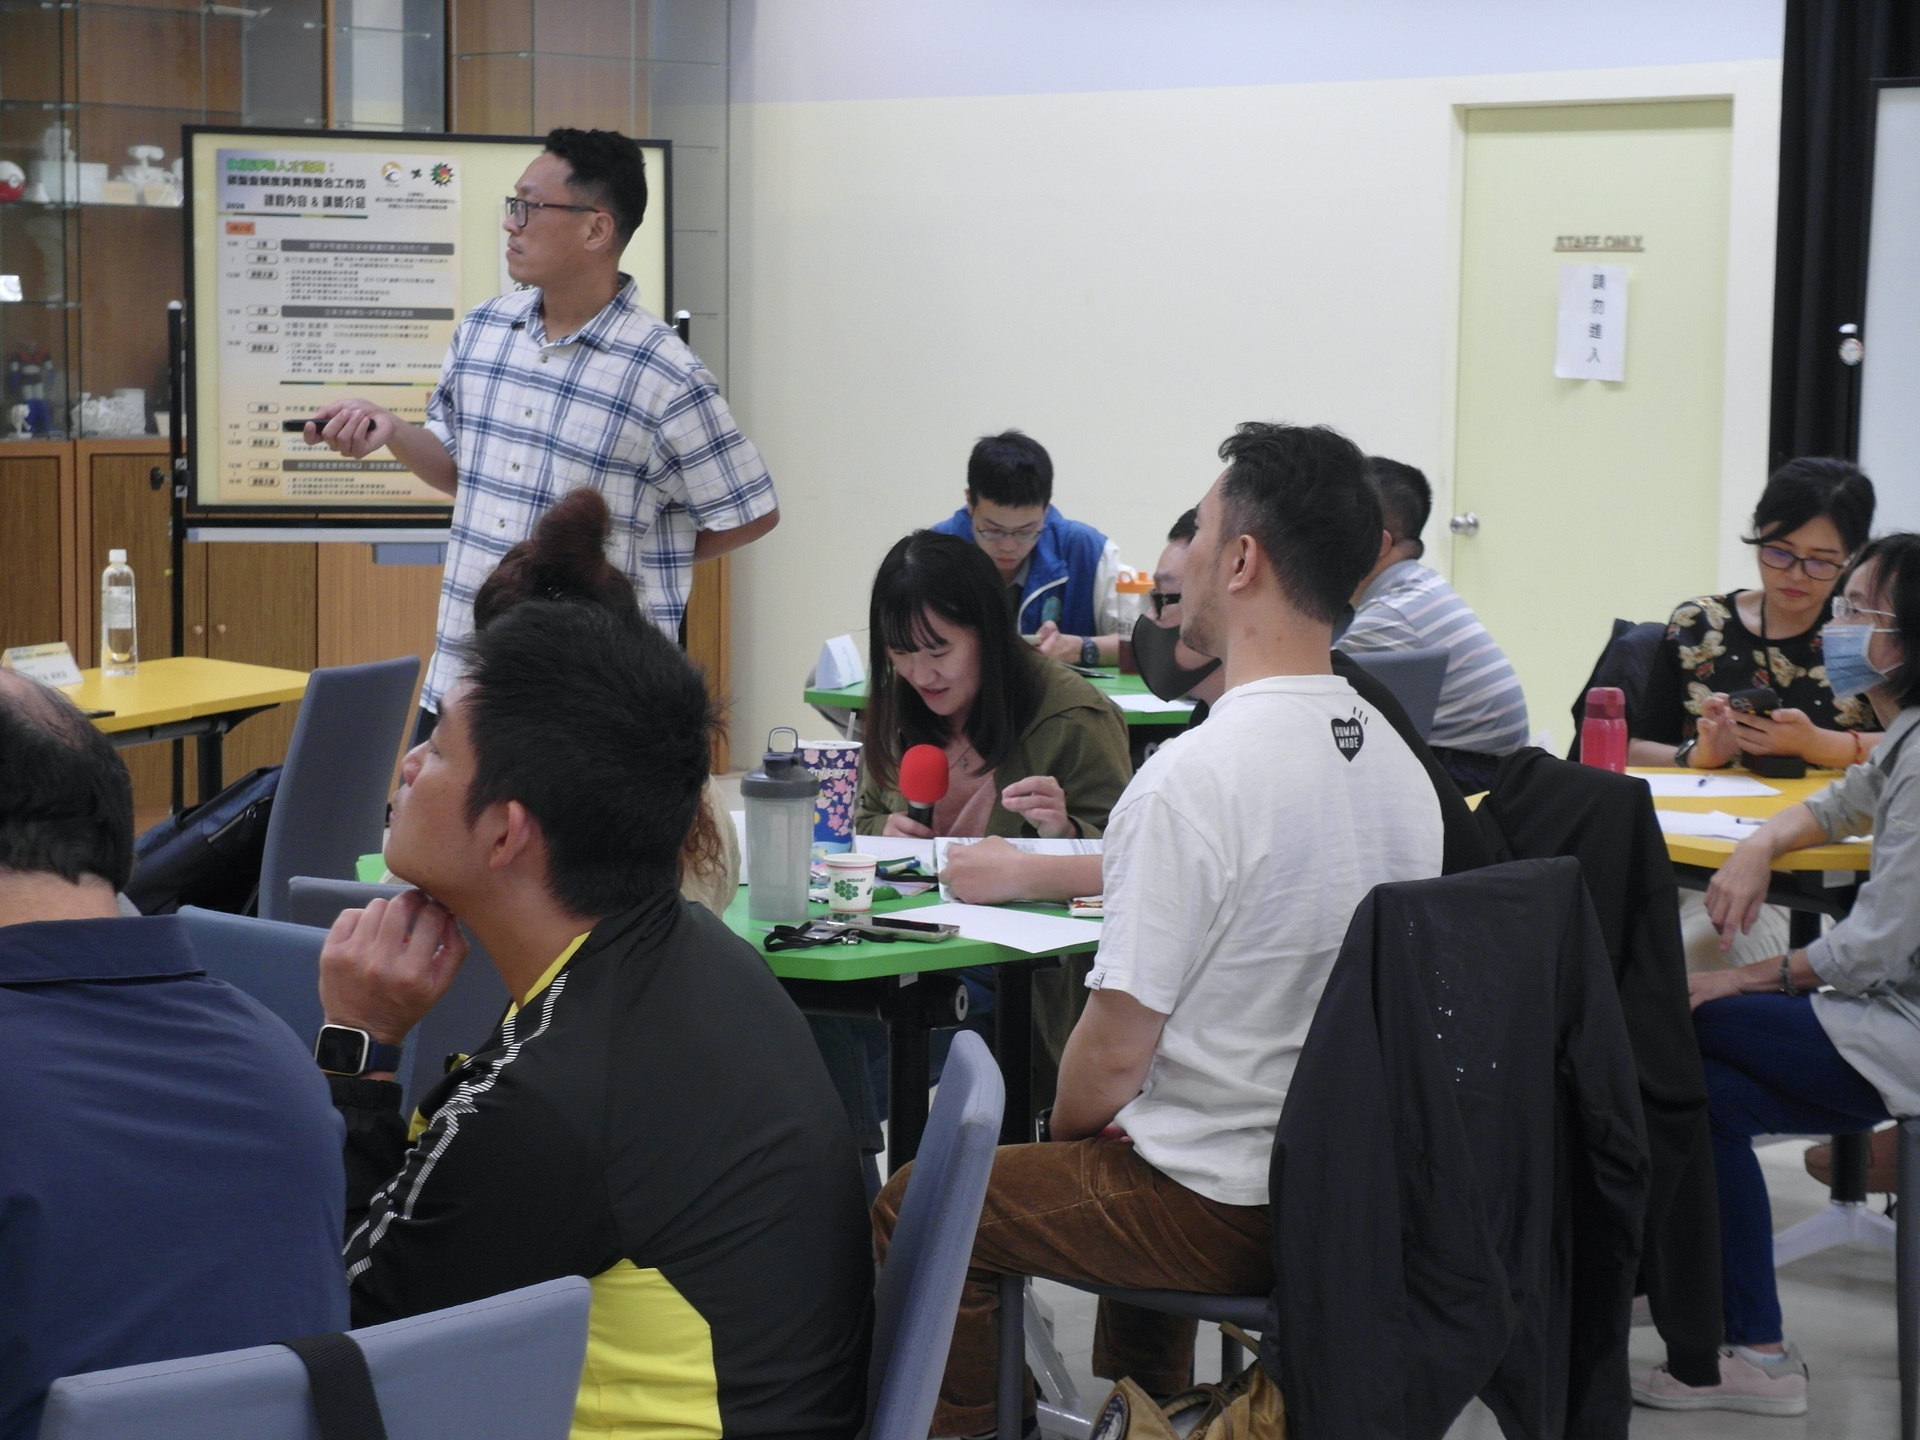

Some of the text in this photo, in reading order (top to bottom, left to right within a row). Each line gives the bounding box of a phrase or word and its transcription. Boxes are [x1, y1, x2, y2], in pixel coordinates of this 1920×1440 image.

[1556, 235, 1644, 249] STAFF ONLY
[1334, 726, 1360, 737] HUMAN
[1338, 737, 1359, 749] MADE
